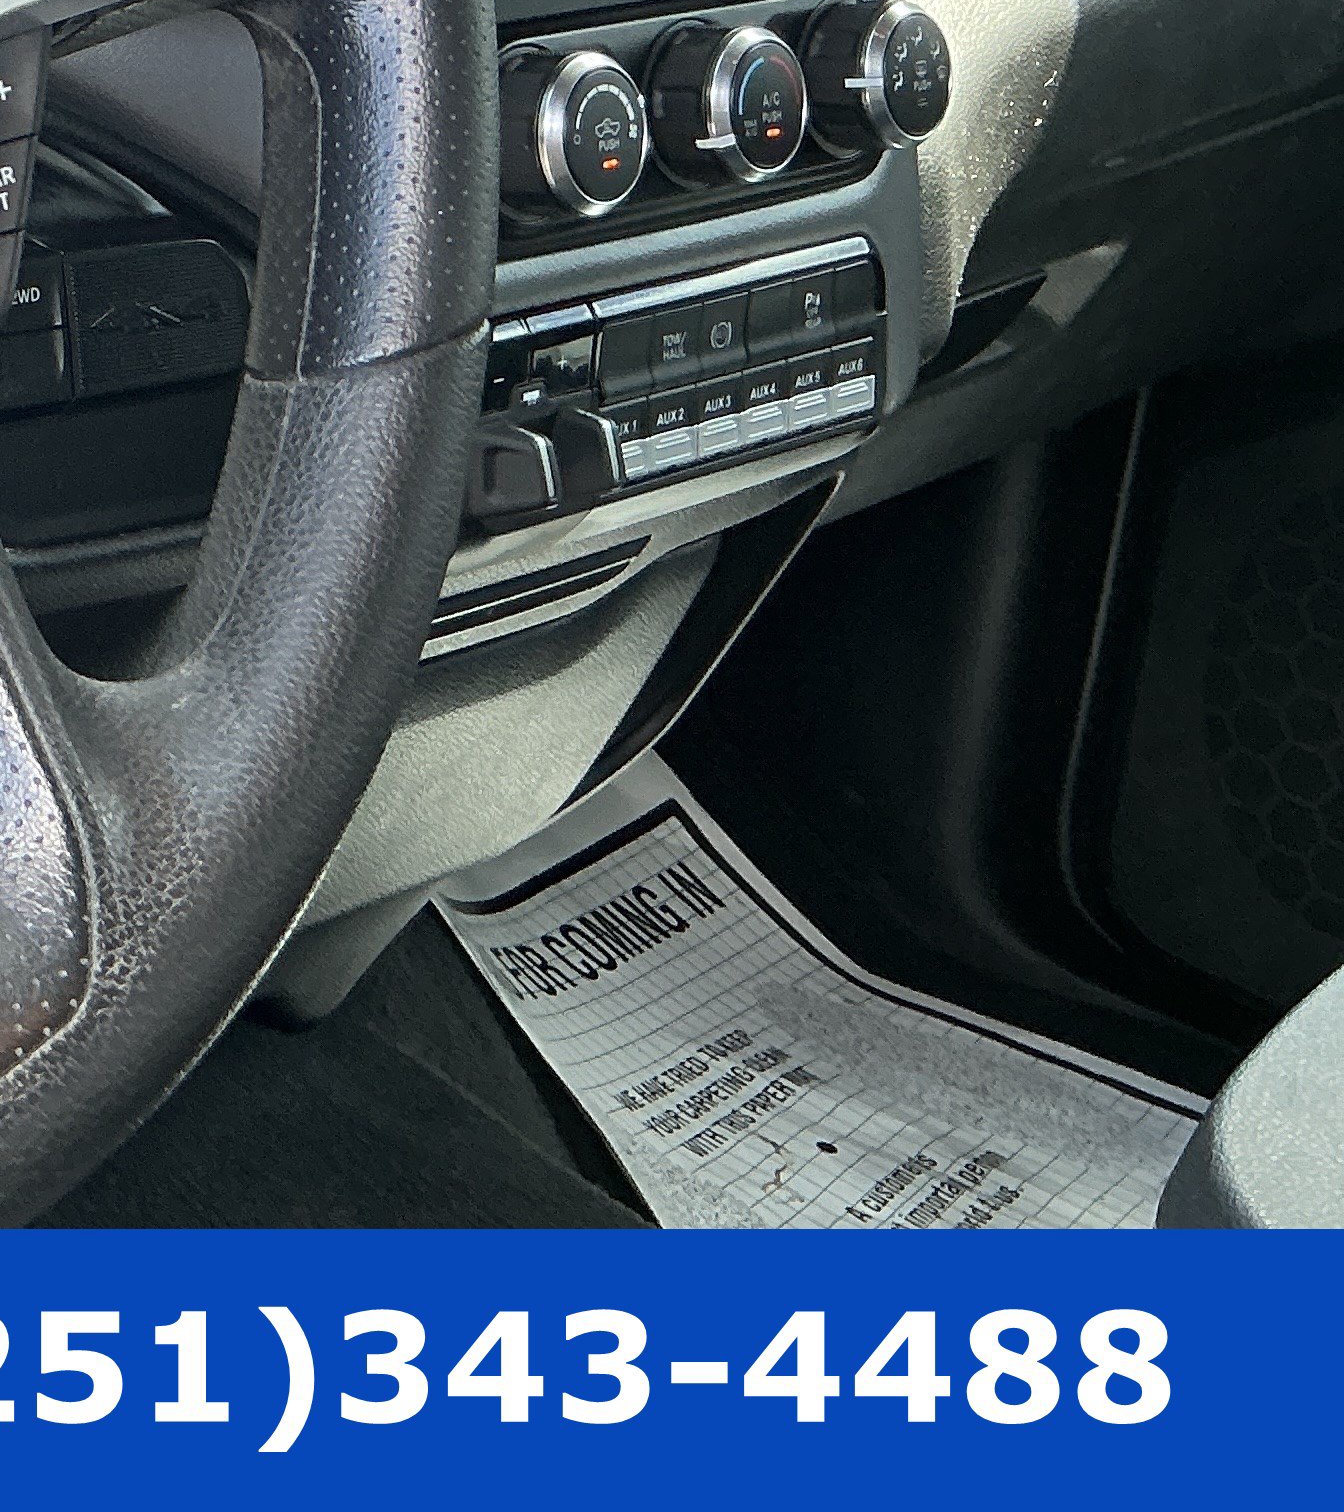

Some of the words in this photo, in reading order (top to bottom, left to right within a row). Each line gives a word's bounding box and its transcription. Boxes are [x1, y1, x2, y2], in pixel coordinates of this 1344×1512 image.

[489, 944, 578, 1001] FOR
[540, 885, 690, 981] COMING
[658, 861, 726, 919] IN
[660, 1056, 710, 1088] TRIED
[642, 1109, 691, 1137] YOUR
[680, 1128, 729, 1158] WITH
[743, 1079, 797, 1116] PAPER
[844, 1206, 873, 1223] A
